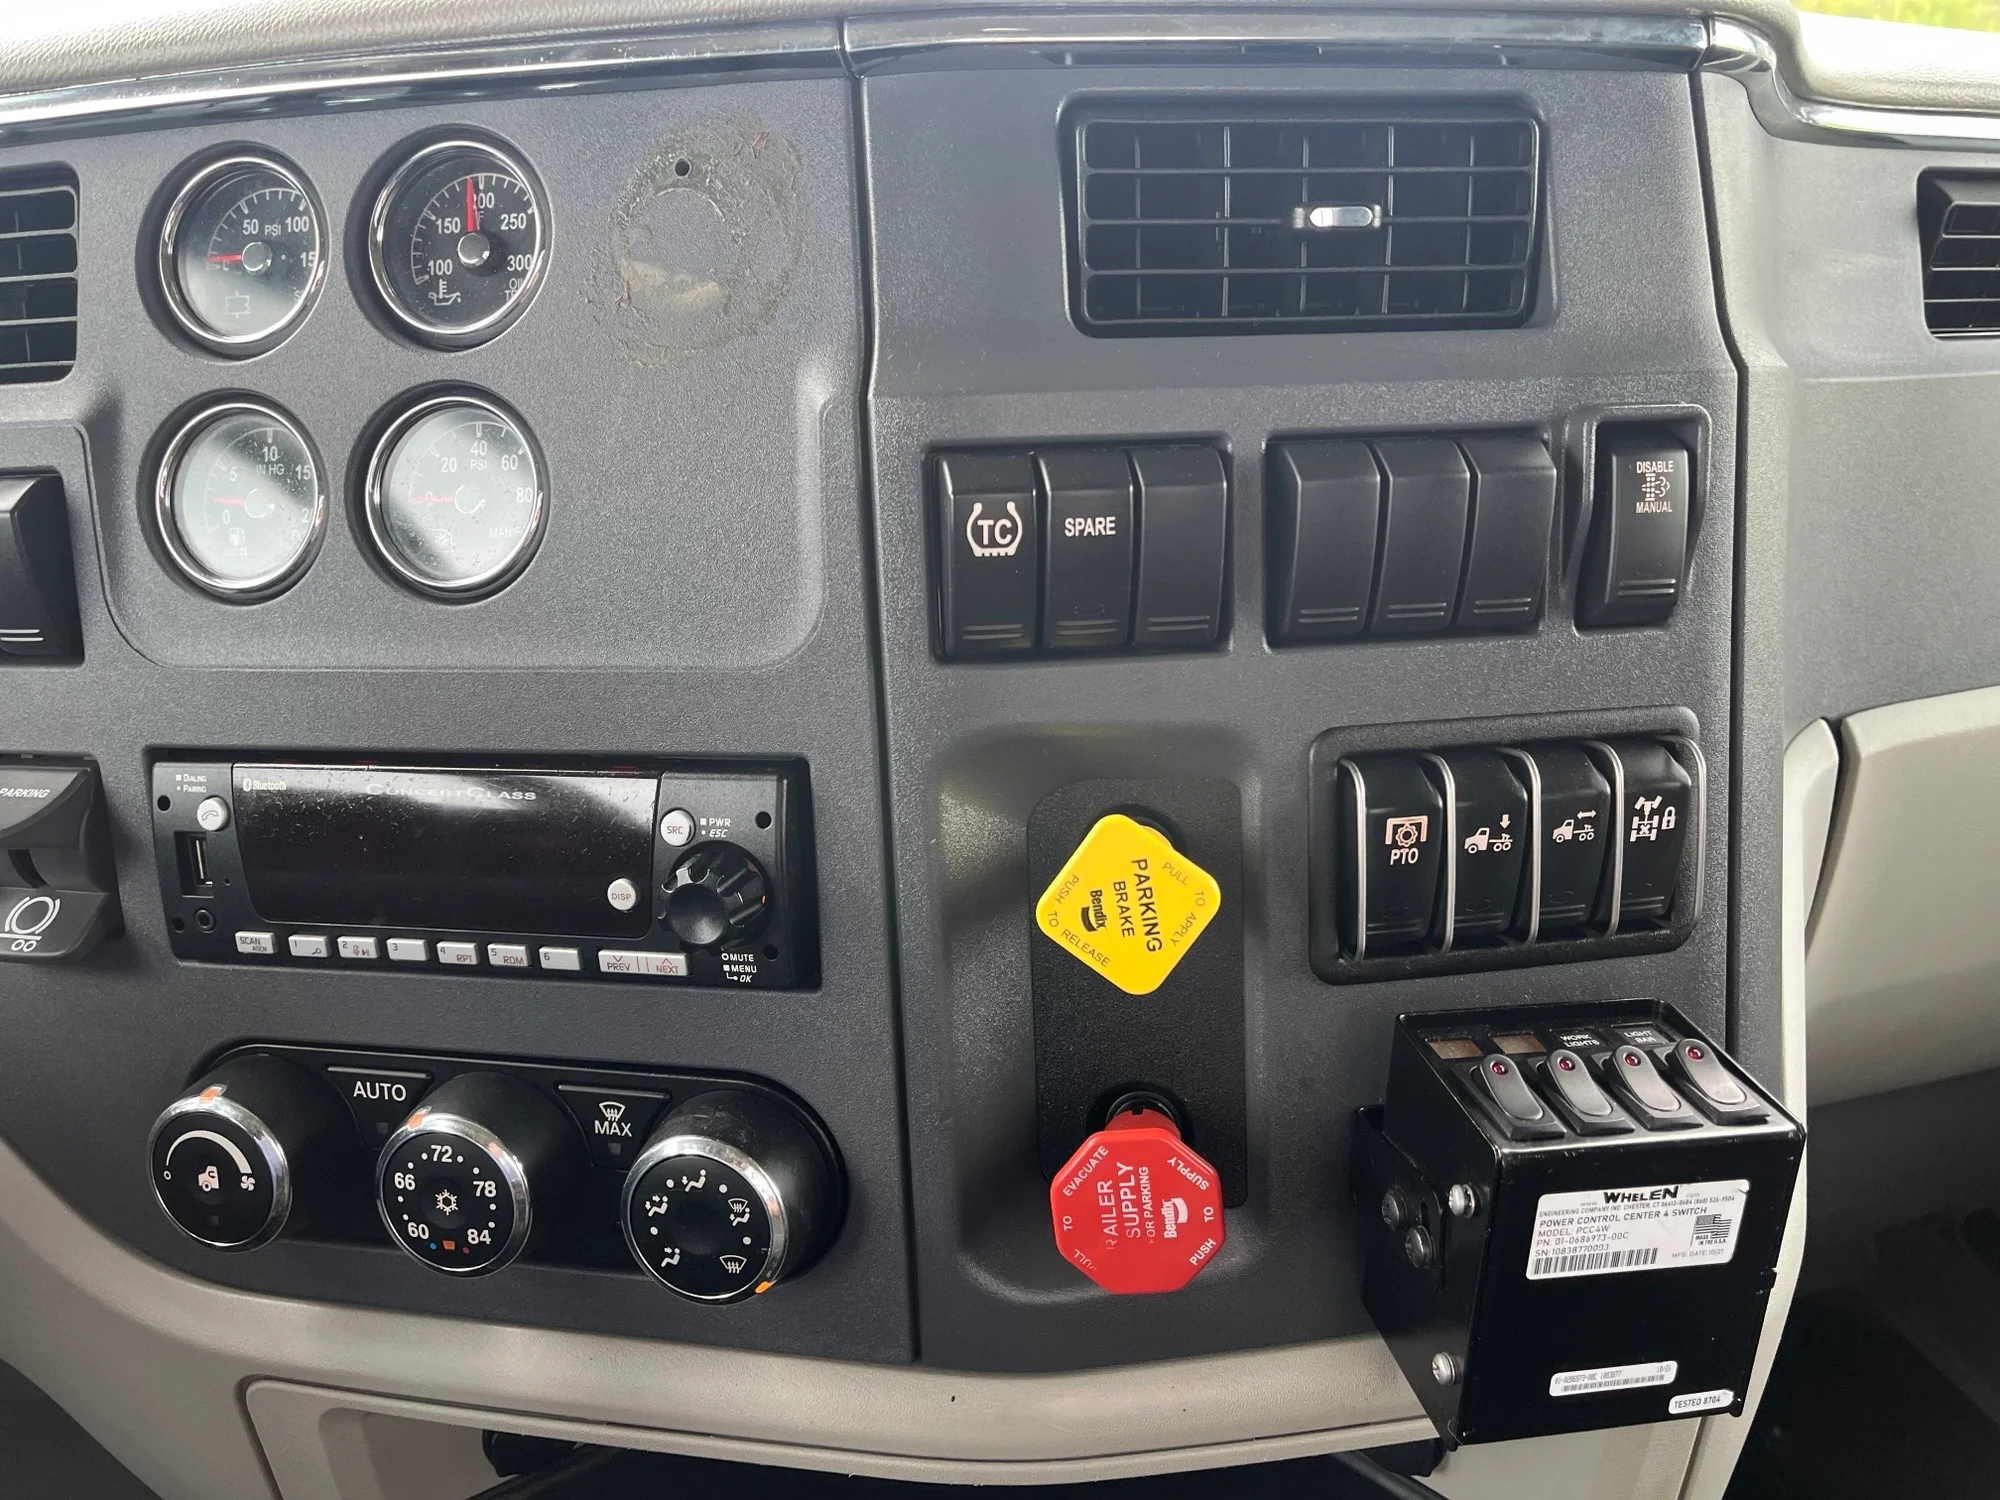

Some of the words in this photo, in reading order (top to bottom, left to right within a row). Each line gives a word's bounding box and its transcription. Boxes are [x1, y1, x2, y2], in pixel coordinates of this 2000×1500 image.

[242, 218, 259, 235] 50
[264, 224, 281, 236] PSI
[285, 216, 309, 233] 100
[436, 217, 461, 234] 150
[500, 213, 526, 230] 250
[428, 259, 453, 276] 100
[506, 254, 533, 271] 300
[262, 445, 278, 462] 10
[470, 440, 488, 456] 40
[268, 463, 285, 476] HG
[440, 456, 457, 473] 20
[470, 459, 487, 471] PSI
[501, 454, 518, 471] 60
[1636, 460, 1674, 474] DISABLE
[229, 466, 237, 482] 5
[295, 464, 312, 480] 15
[515, 486, 533, 503] 80
[1636, 501, 1673, 514] MANUAL
[222, 509, 230, 525] 0
[977, 519, 1013, 546] TC
[1064, 516, 1116, 538] SPARE
[183, 773, 207, 783] DIALING
[252, 780, 287, 791] Bluetooth
[0, 787, 51, 799] PARKING
[183, 784, 207, 793] PAIRING
[667, 825, 683, 835] SRC
[709, 817, 731, 827] PWR
[709, 829, 729, 838] ESC
[1390, 846, 1419, 866] PTO
[1162, 862, 1188, 886] PULL
[611, 893, 632, 901] DISP
[1054, 874, 1080, 904] PUSH
[1131, 858, 1163, 952] PARKING
[1195, 890, 1206, 907] TO
[1090, 889, 1108, 930] Bendix
[1113, 880, 1135, 939] BRAKE
[1048, 910, 1060, 928] TO
[1170, 912, 1197, 947] APPLY
[240, 936, 260, 945] SCAN
[342, 940, 348, 949] 2
[392, 943, 399, 951] 3
[1061, 929, 1111, 968] RELEASE
[440, 947, 446, 955] 4
[456, 954, 473, 963] RPT
[491, 948, 498, 956] 5
[543, 952, 551, 961] 6
[730, 953, 754, 962] MUTE
[503, 955, 525, 965] RDM
[606, 962, 631, 972] PREV
[731, 964, 757, 973] MENU
[656, 964, 679, 974] NEXT
[739, 974, 752, 983] OK
[1560, 1033, 1593, 1041] WORK
[1624, 1030, 1652, 1038] LIGHT
[1563, 1039, 1600, 1048] LIGHTS
[353, 1080, 407, 1102] AUTO
[594, 1120, 633, 1137] MAX
[430, 1144, 453, 1163] 72
[1062, 1145, 1109, 1197] EVACUATE
[1167, 1156, 1209, 1191] SUPPLY
[394, 1171, 416, 1191] 66
[473, 1179, 497, 1198] 78
[1116, 1161, 1141, 1238] SUPPLY
[1138, 1166, 1154, 1218] PARKING
[1603, 1185, 1679, 1204] WHELEN
[1097, 1180, 1119, 1250] RAILER
[1161, 1198, 1178, 1239] Bendix
[1203, 1206, 1215, 1223] TO
[1540, 1208, 1579, 1218] ENGINEERING
[1581, 1205, 1610, 1214] COMPANY
[1540, 1217, 1574, 1228] POWER
[1577, 1214, 1621, 1225] CONTROL
[1623, 1210, 1661, 1221] CENTER
[1663, 1209, 1669, 1217] 4
[1672, 1206, 1707, 1217] SWITCH
[407, 1222, 430, 1240] 60
[1062, 1215, 1073, 1231] TO
[1538, 1228, 1572, 1238] MODEL:
[1576, 1224, 1610, 1235] PCC4W
[467, 1228, 492, 1246] 84
[1189, 1238, 1217, 1266] PUSH
[1674, 1398, 1702, 1409] TESTED
